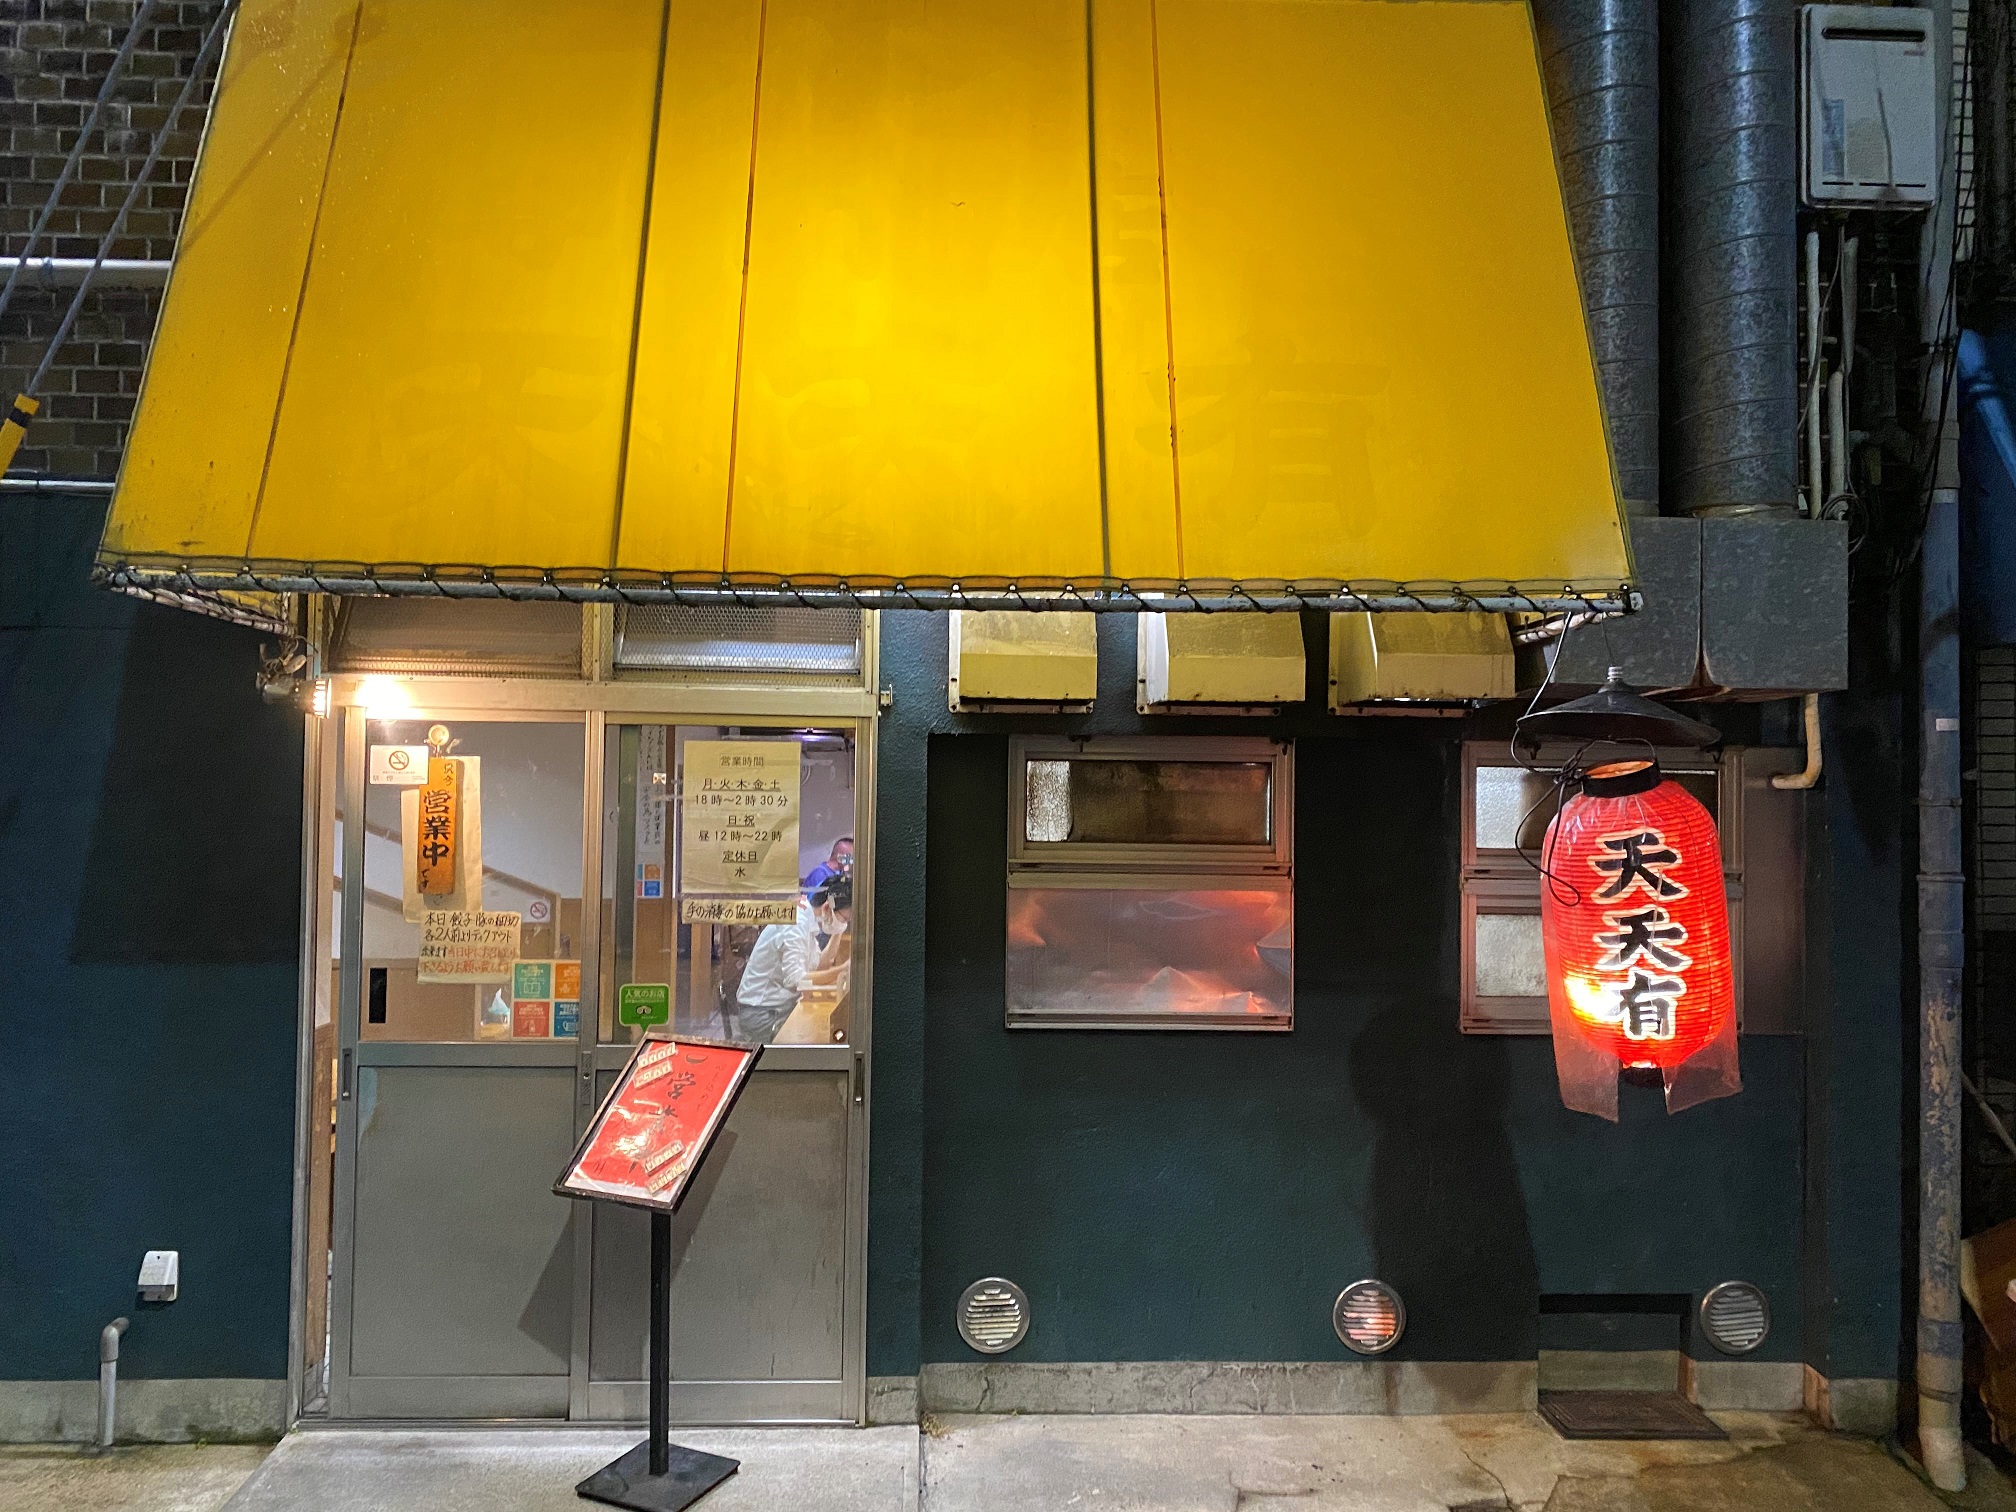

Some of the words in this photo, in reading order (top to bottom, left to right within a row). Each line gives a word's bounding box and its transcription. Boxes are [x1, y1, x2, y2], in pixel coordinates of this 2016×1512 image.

[720, 756, 765, 768] 営業時間
[727, 815, 755, 826] 日・祝
[422, 788, 452, 867] 営業中
[722, 850, 759, 862] 定休日
[734, 866, 746, 877] 水
[1588, 828, 1692, 1039] 天天有
